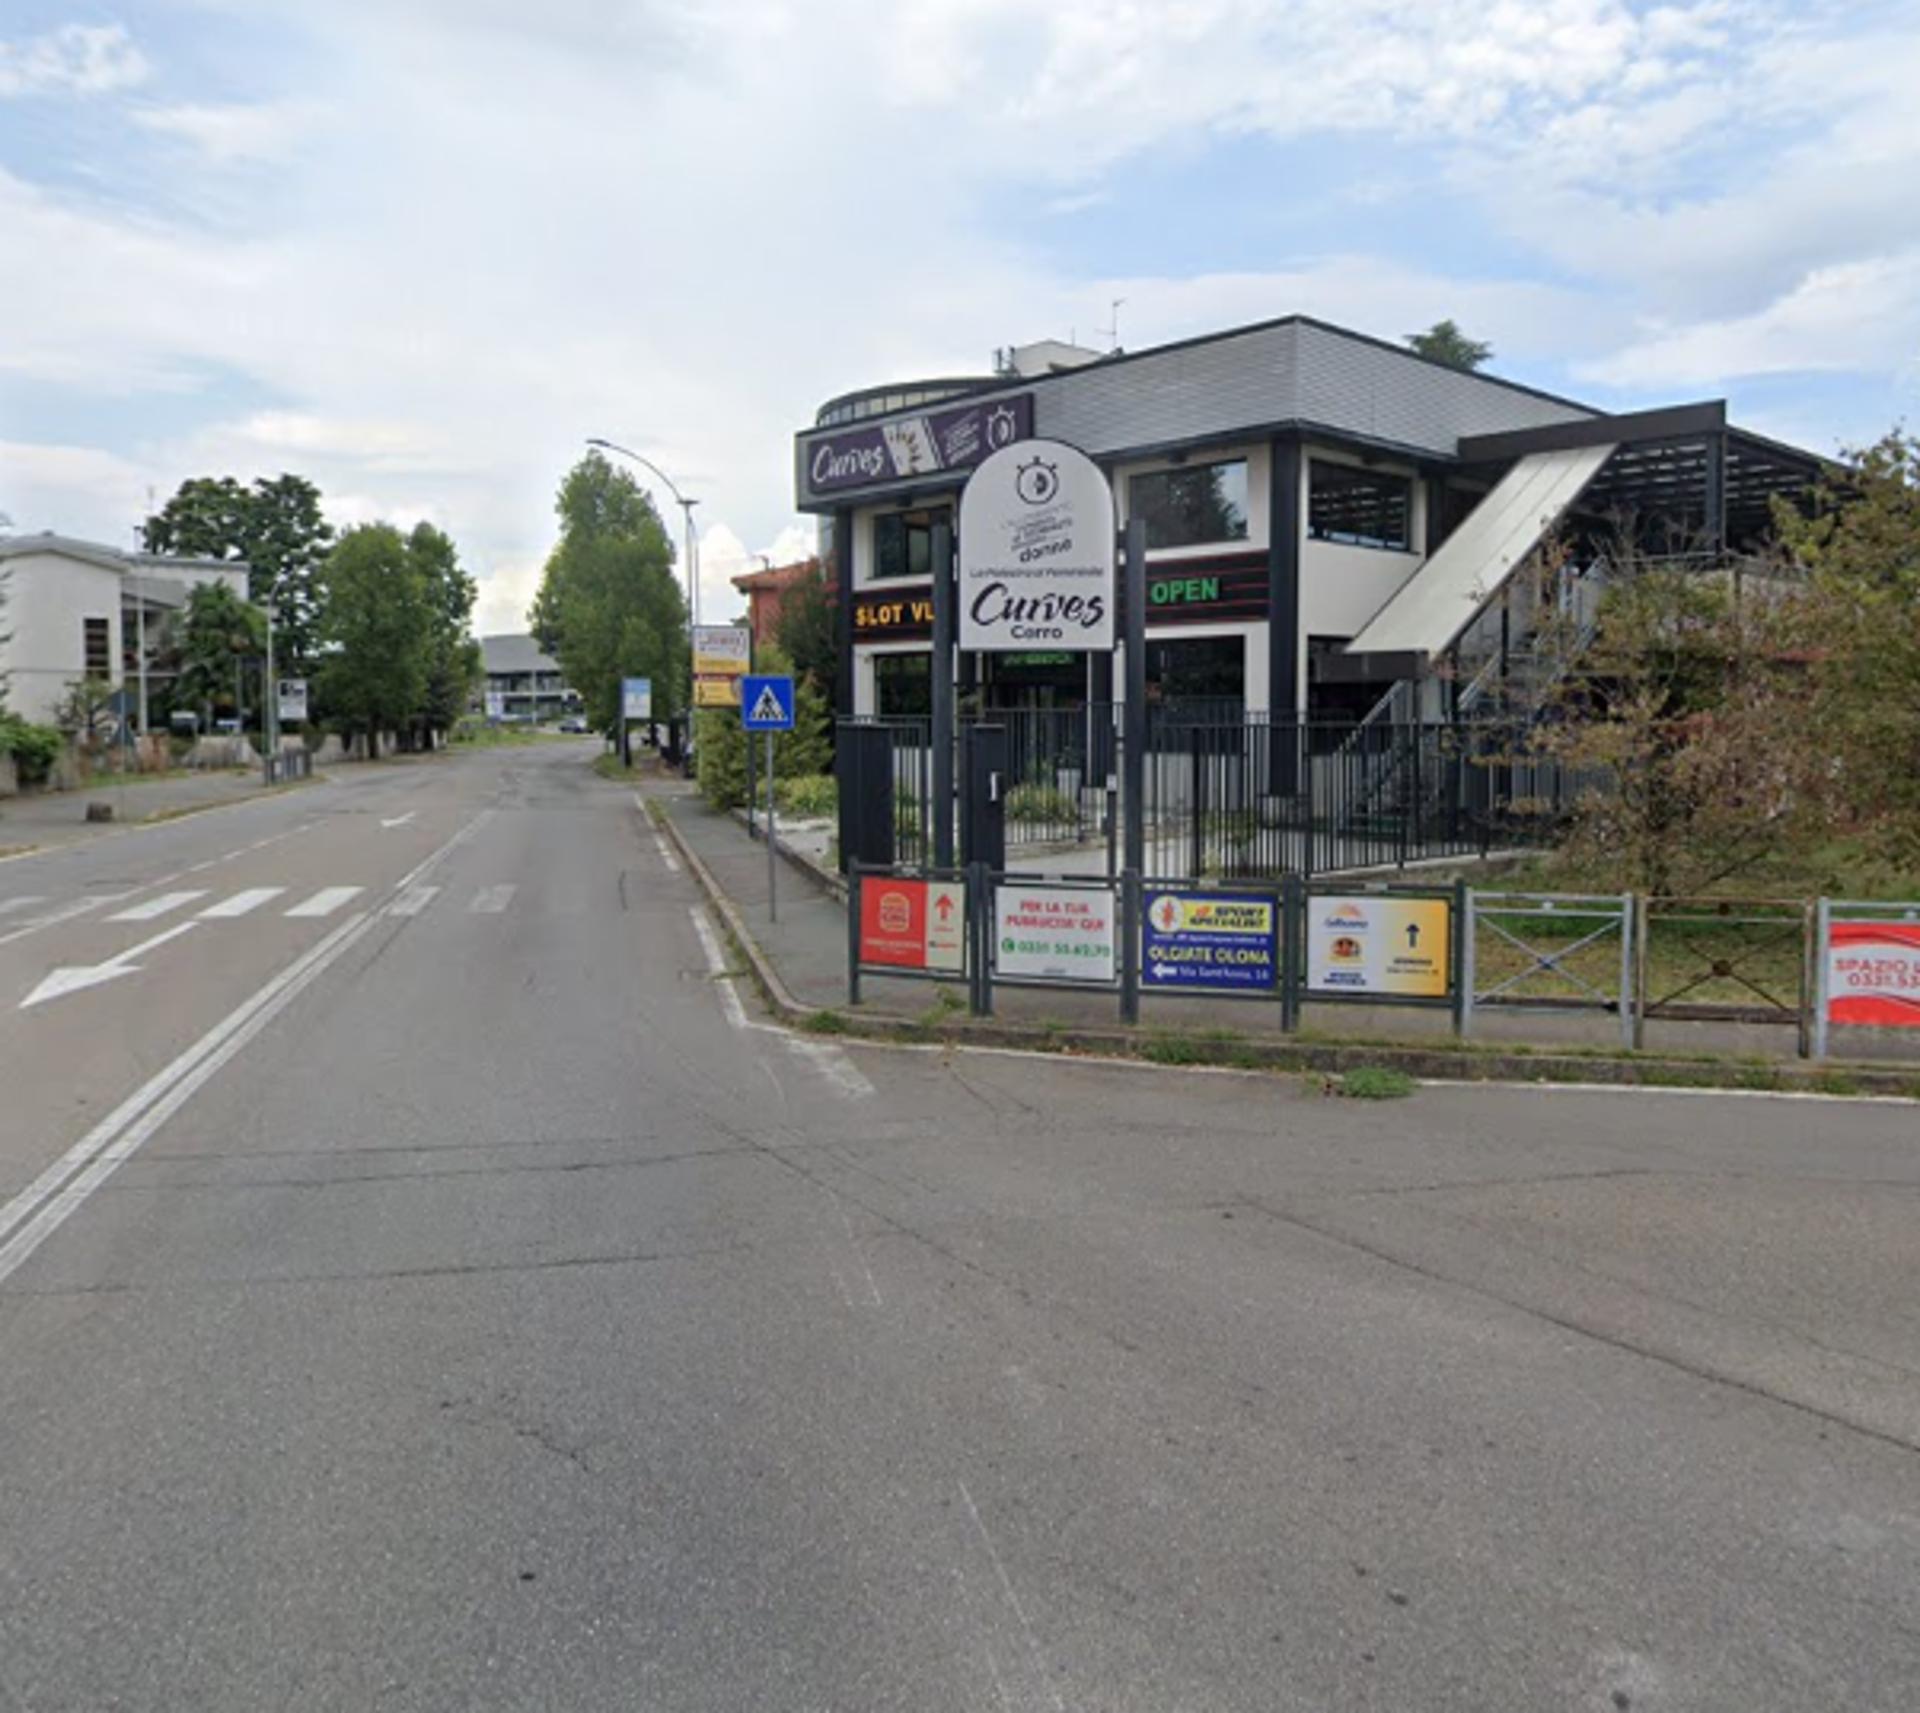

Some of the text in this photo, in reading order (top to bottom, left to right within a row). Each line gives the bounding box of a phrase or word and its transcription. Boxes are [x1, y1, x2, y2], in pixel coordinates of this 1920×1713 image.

[812, 445, 884, 483] Curves
[1151, 578, 1219, 604] OPEN
[856, 604, 903, 627] SLOT
[970, 581, 1105, 629] Curves
[1148, 945, 1271, 965] OLGIATE OLONA
